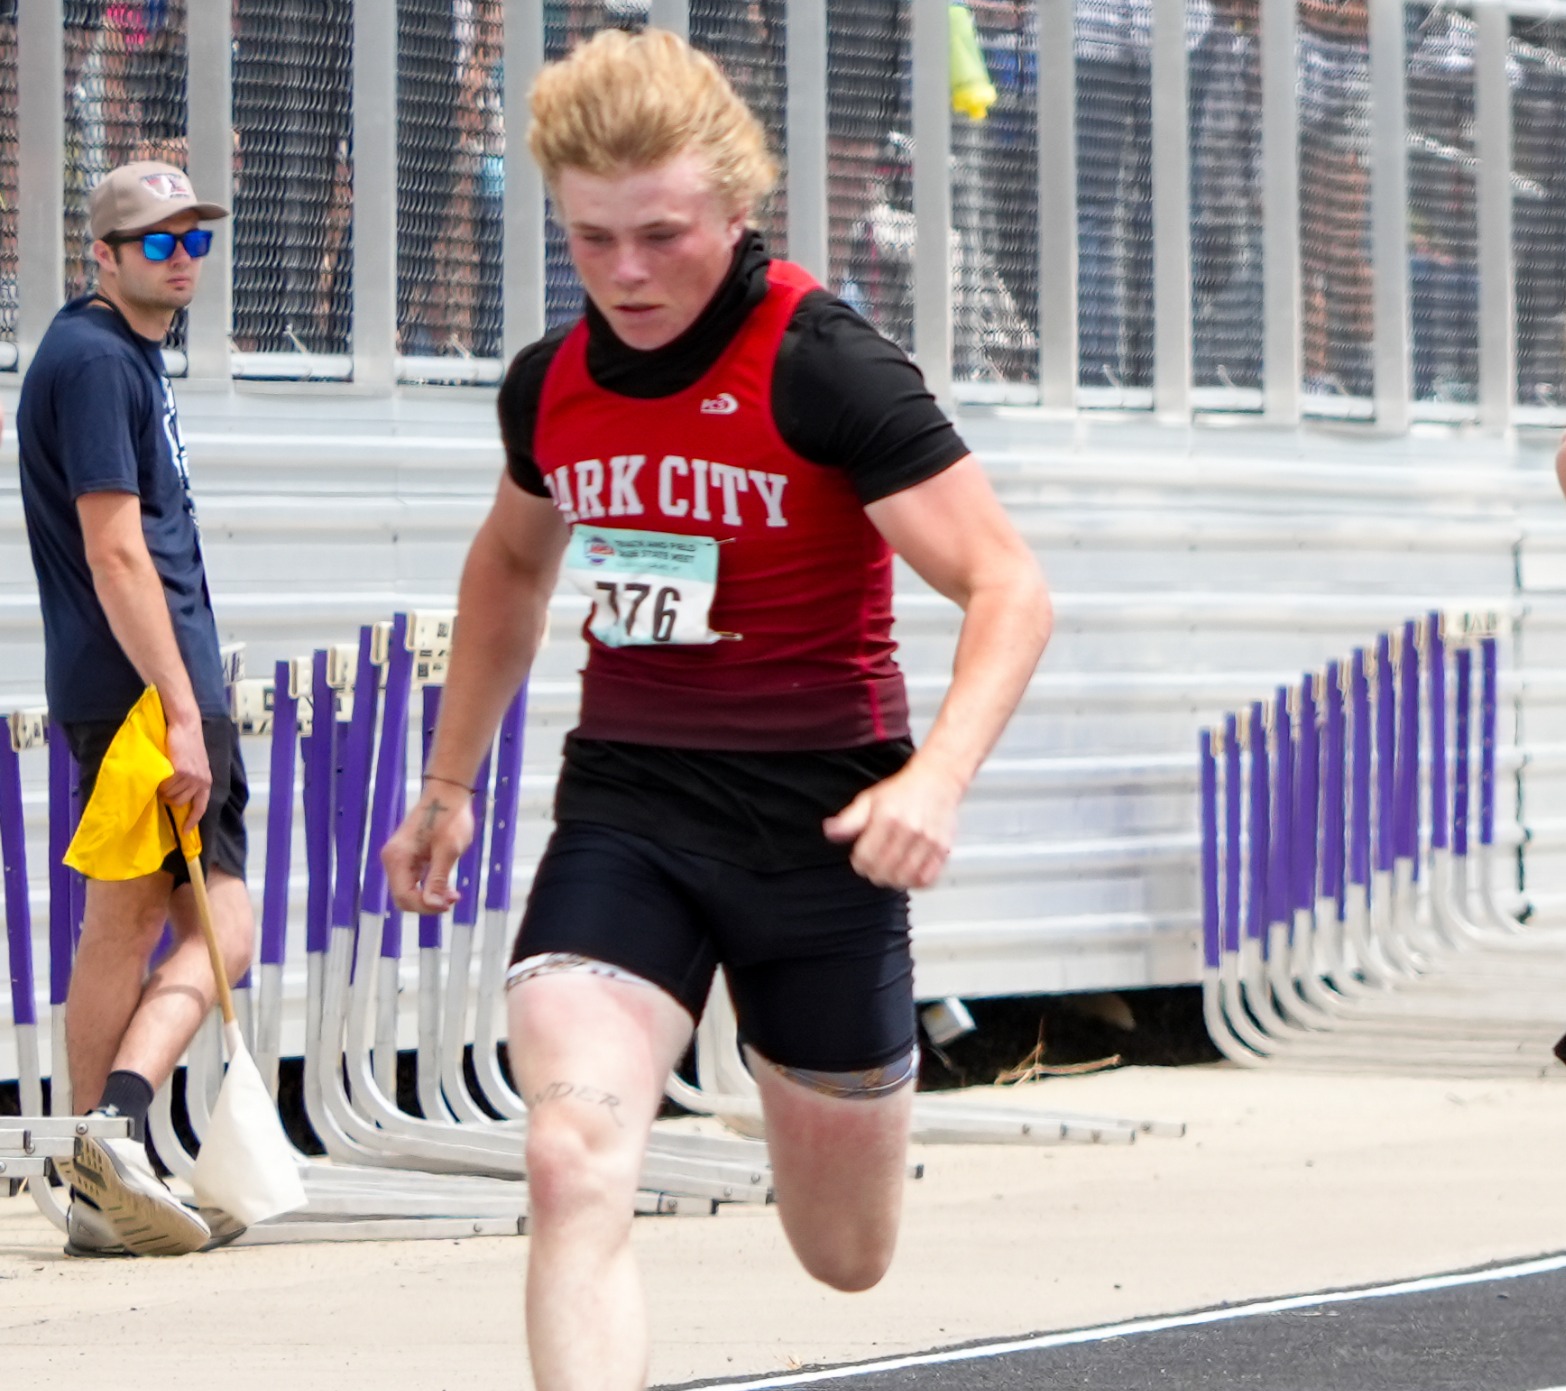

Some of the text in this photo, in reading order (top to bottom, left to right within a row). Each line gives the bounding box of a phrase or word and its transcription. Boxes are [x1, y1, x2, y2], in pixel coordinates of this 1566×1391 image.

[544, 454, 789, 528] ARK CITY
[596, 581, 681, 642] 776
